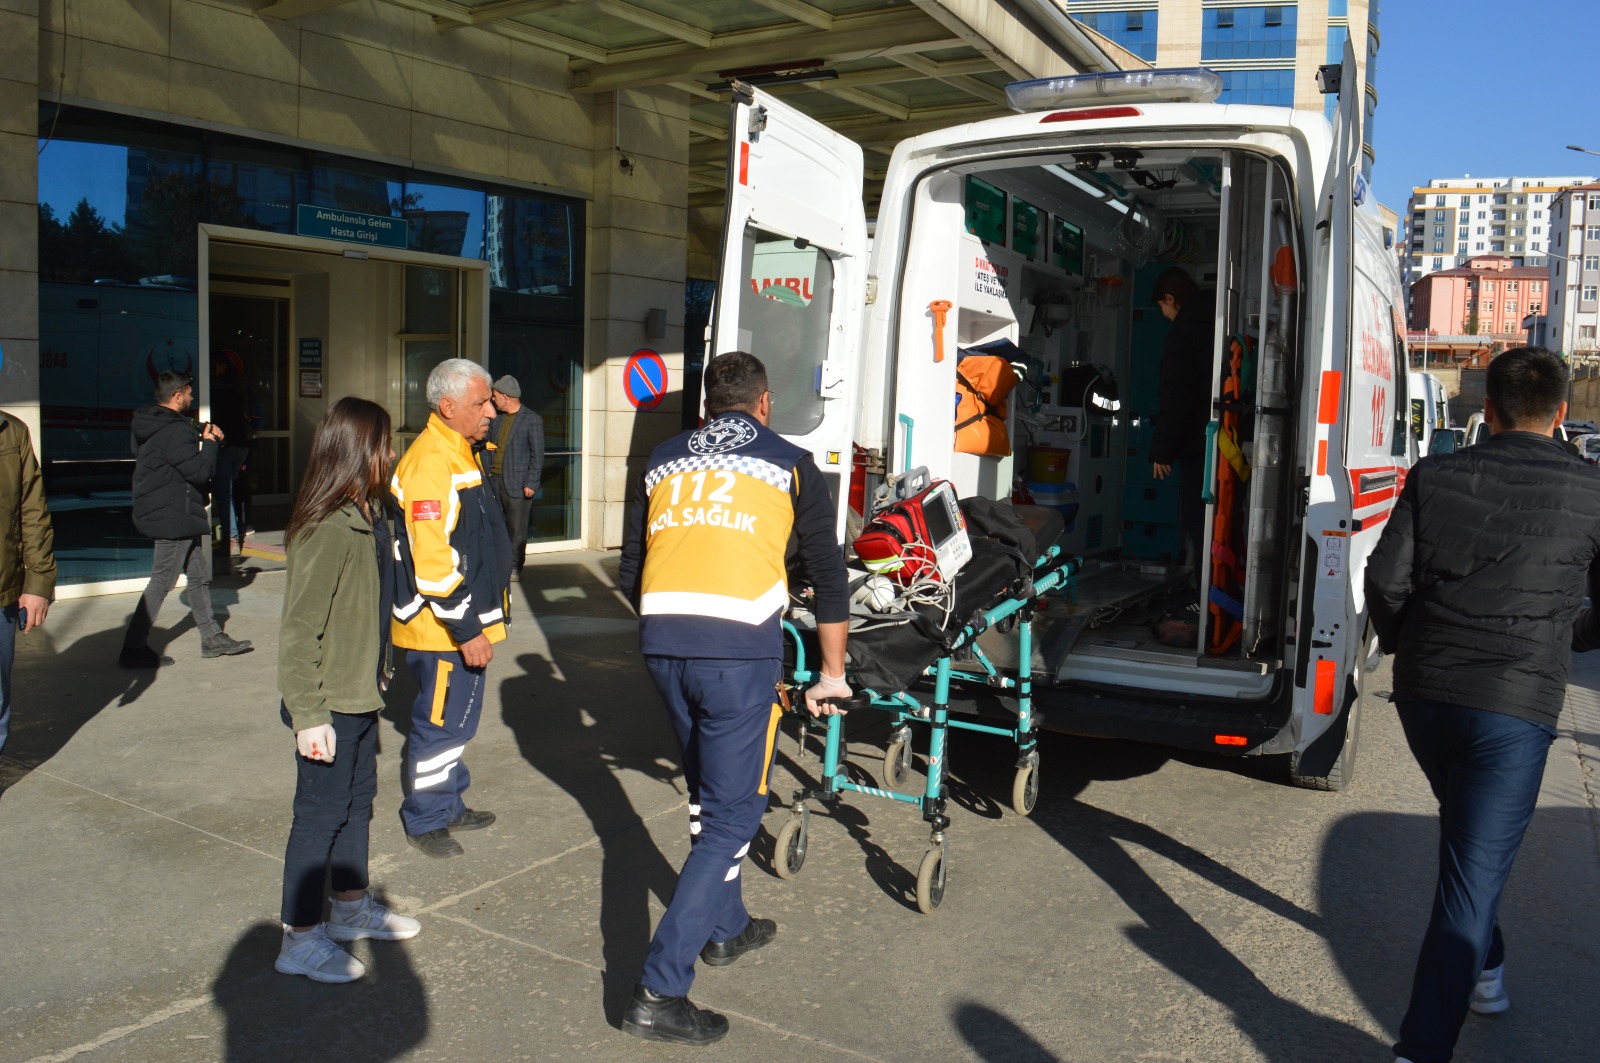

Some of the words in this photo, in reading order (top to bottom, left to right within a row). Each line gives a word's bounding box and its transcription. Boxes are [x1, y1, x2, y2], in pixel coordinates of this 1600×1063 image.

[316, 210, 366, 226] Ambulansla
[367, 218, 392, 229] Gelen
[331, 226, 355, 238] Hasta
[356, 230, 378, 242] Girişi
[1371, 384, 1386, 447] 112
[670, 470, 736, 506] 112
[682, 503, 758, 534] SAĞLIK
